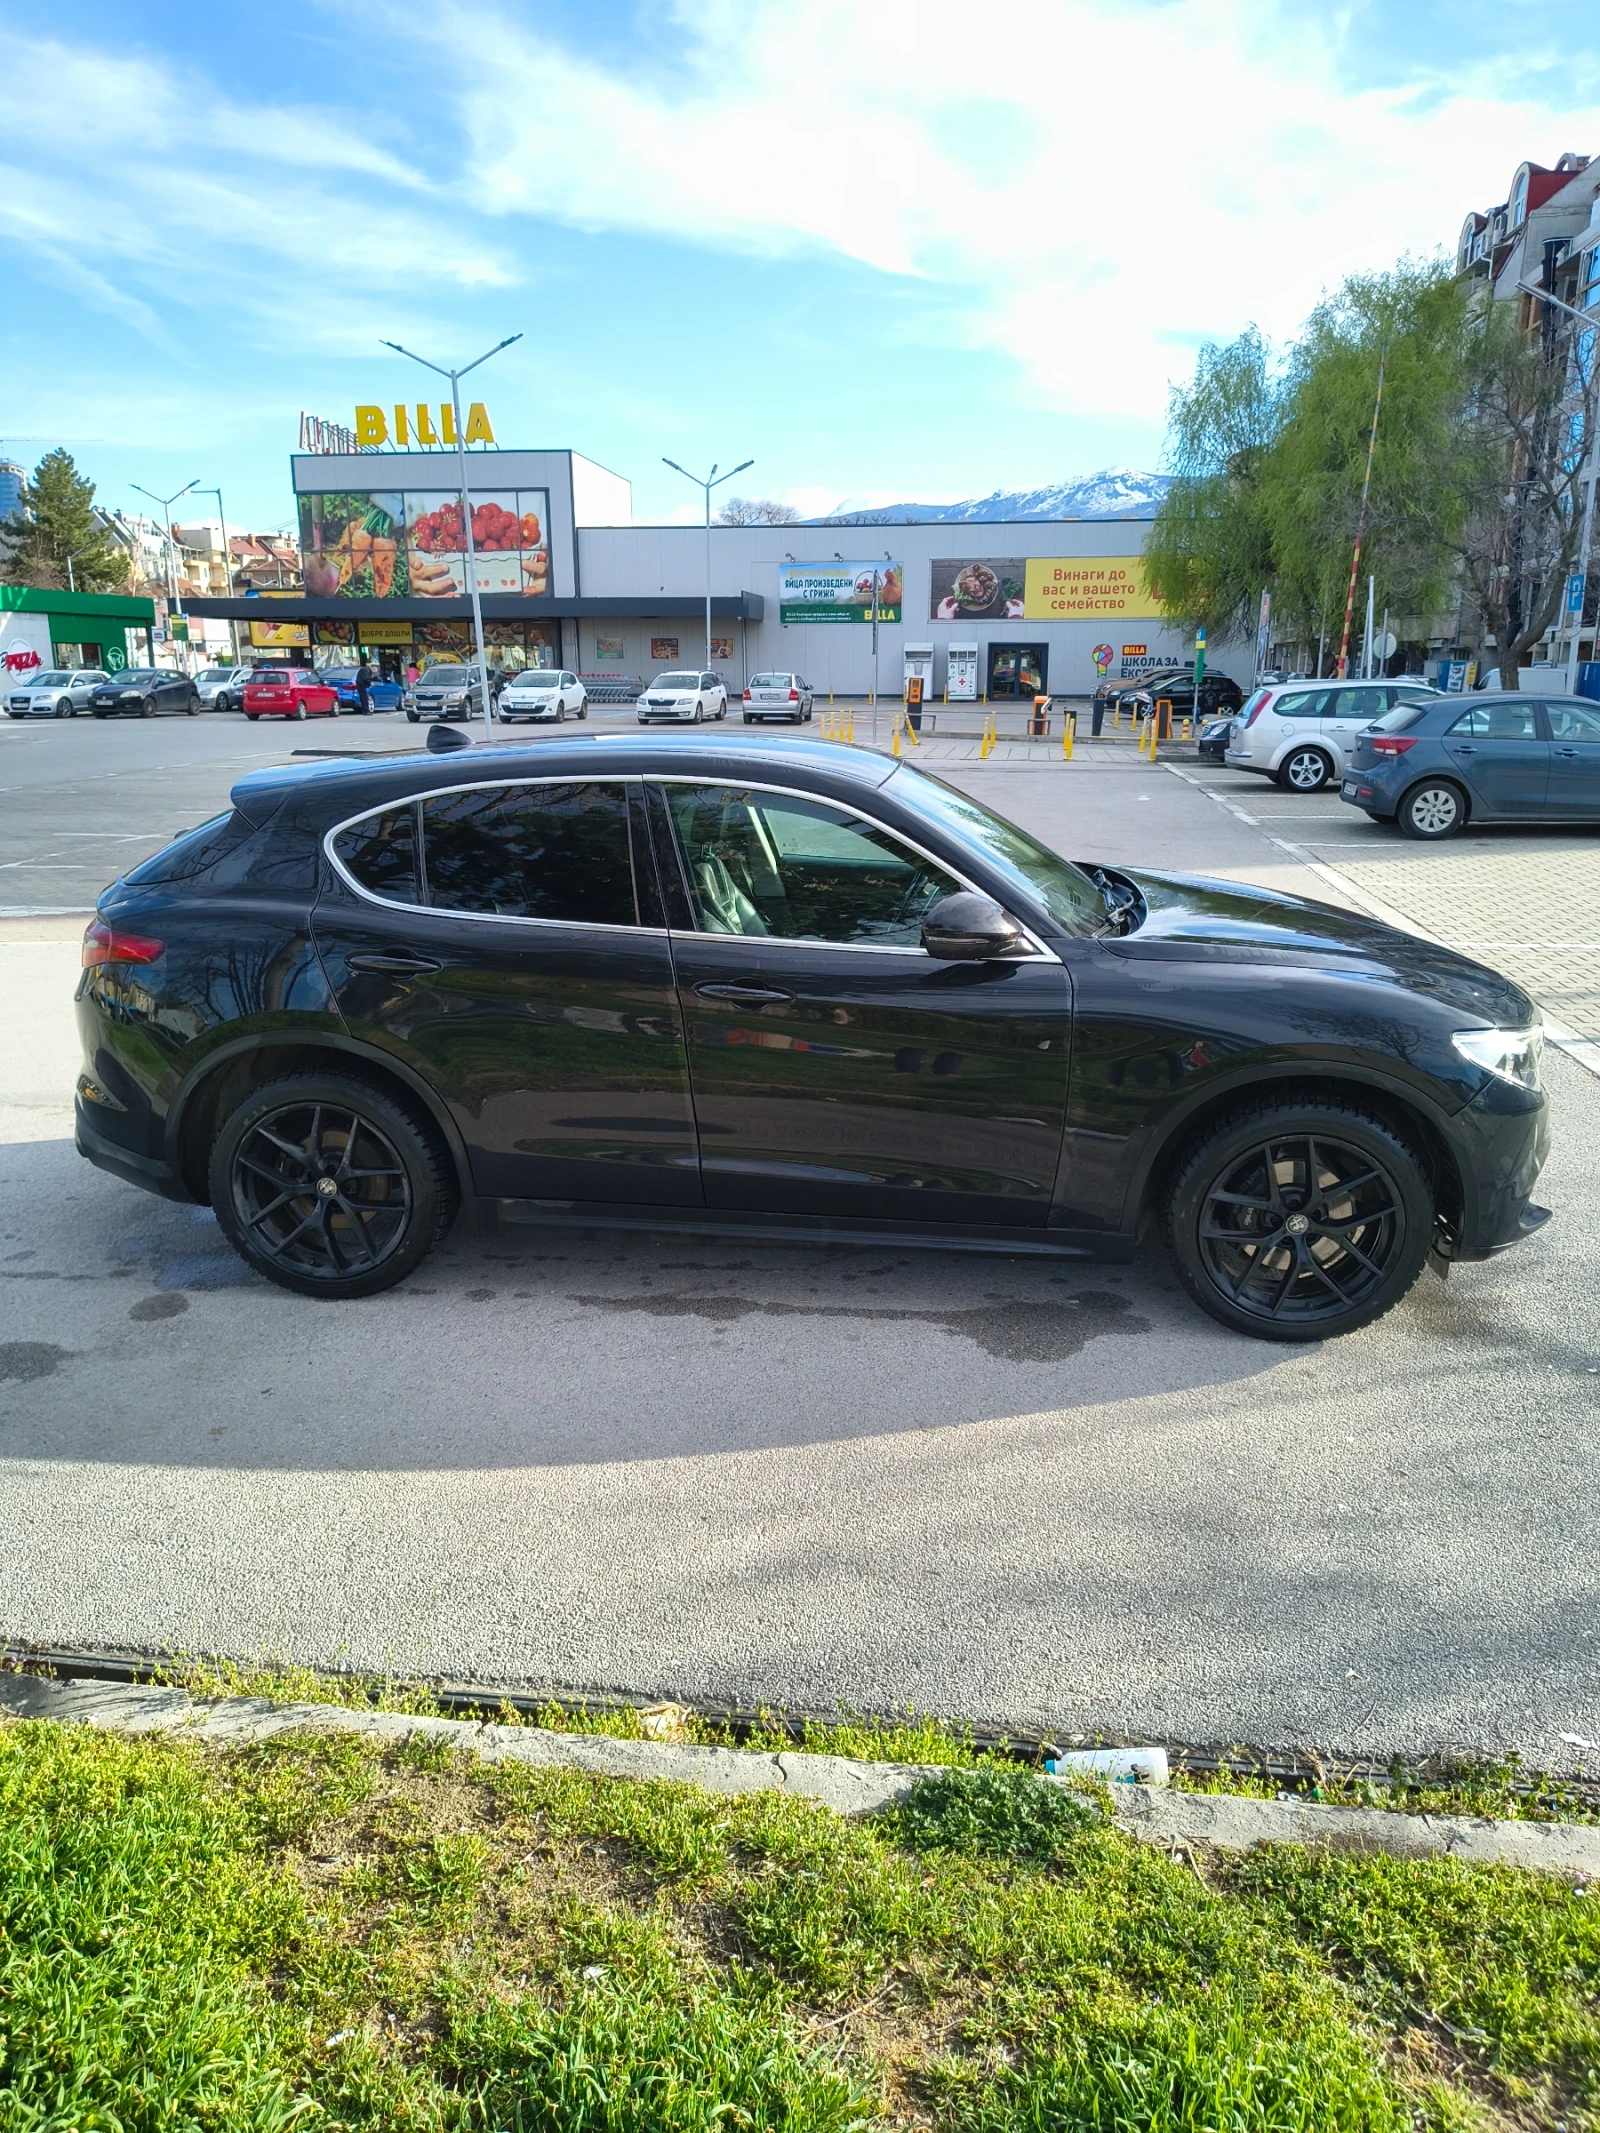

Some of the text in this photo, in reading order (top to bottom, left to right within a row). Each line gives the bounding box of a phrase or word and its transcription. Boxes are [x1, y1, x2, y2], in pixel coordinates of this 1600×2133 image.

[355, 403, 494, 446] BILLA
[1053, 568, 1126, 582] Винаги до
[785, 577, 853, 589] ЯЙЦА ПРОИЗВЕДЕНИ
[803, 589, 835, 598] С ГРИЖА
[1042, 584, 1135, 596] вас и вашето
[1051, 597, 1125, 610] семейство
[864, 609, 895, 620] BLLA
[361, 630, 411, 638] ДОБРЕ ДОШЛИ
[1123, 646, 1145, 655] BILLA
[1121, 657, 1179, 667] ШКОЛА ЗА
